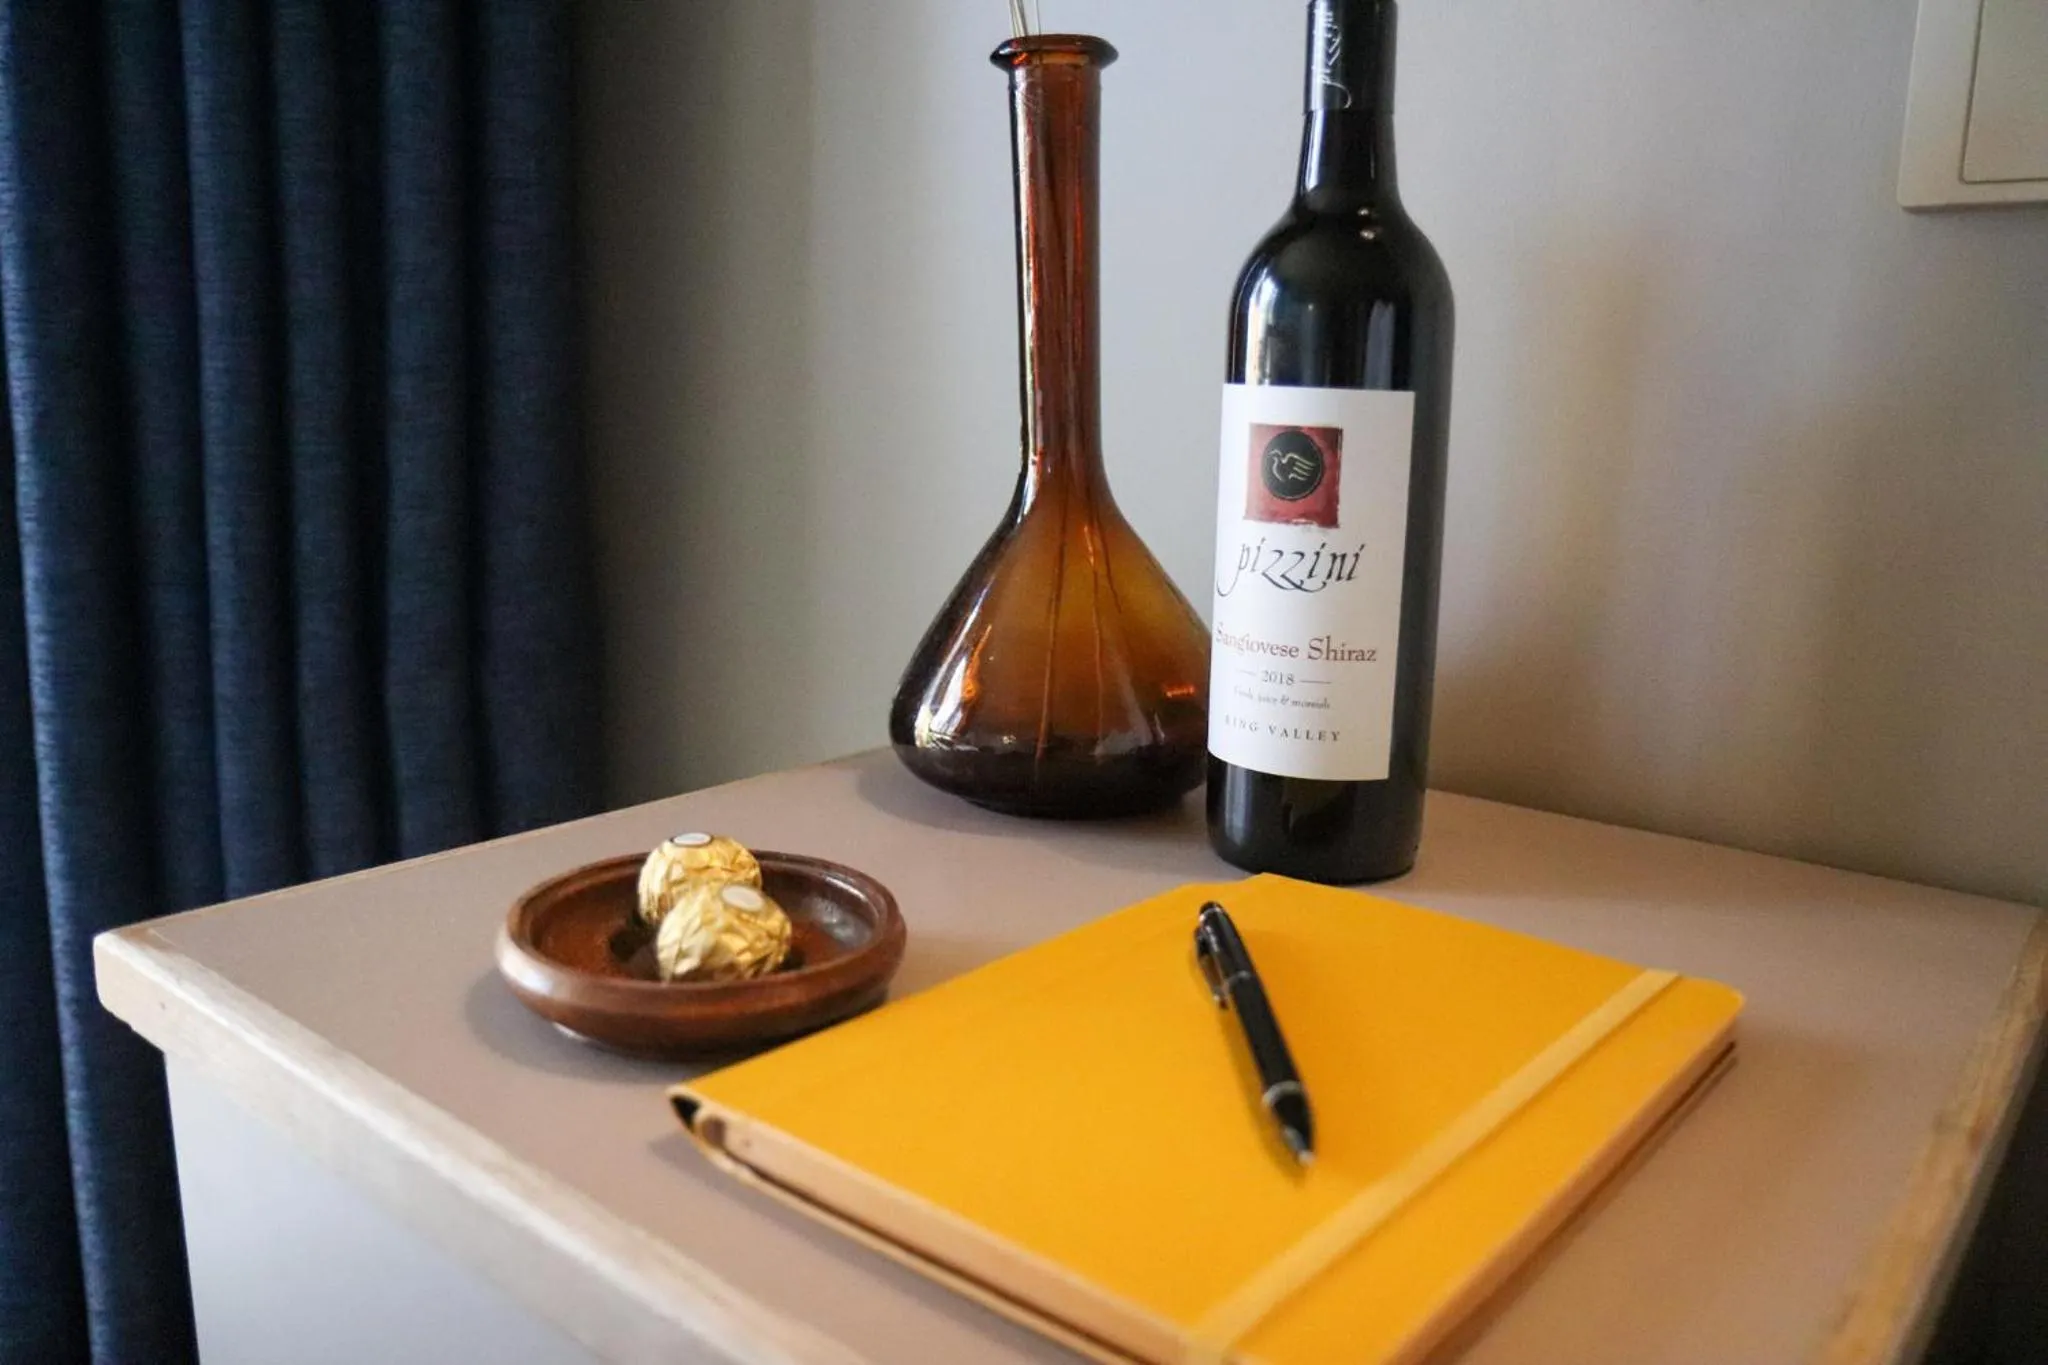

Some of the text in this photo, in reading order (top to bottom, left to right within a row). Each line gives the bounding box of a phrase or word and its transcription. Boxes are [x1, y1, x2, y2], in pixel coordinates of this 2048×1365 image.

[1216, 537, 1366, 597] pizzini
[1215, 622, 1378, 662] Sangiovese Shiraz
[1261, 670, 1296, 686] 2018
[1268, 725, 1341, 742] VALLEY
